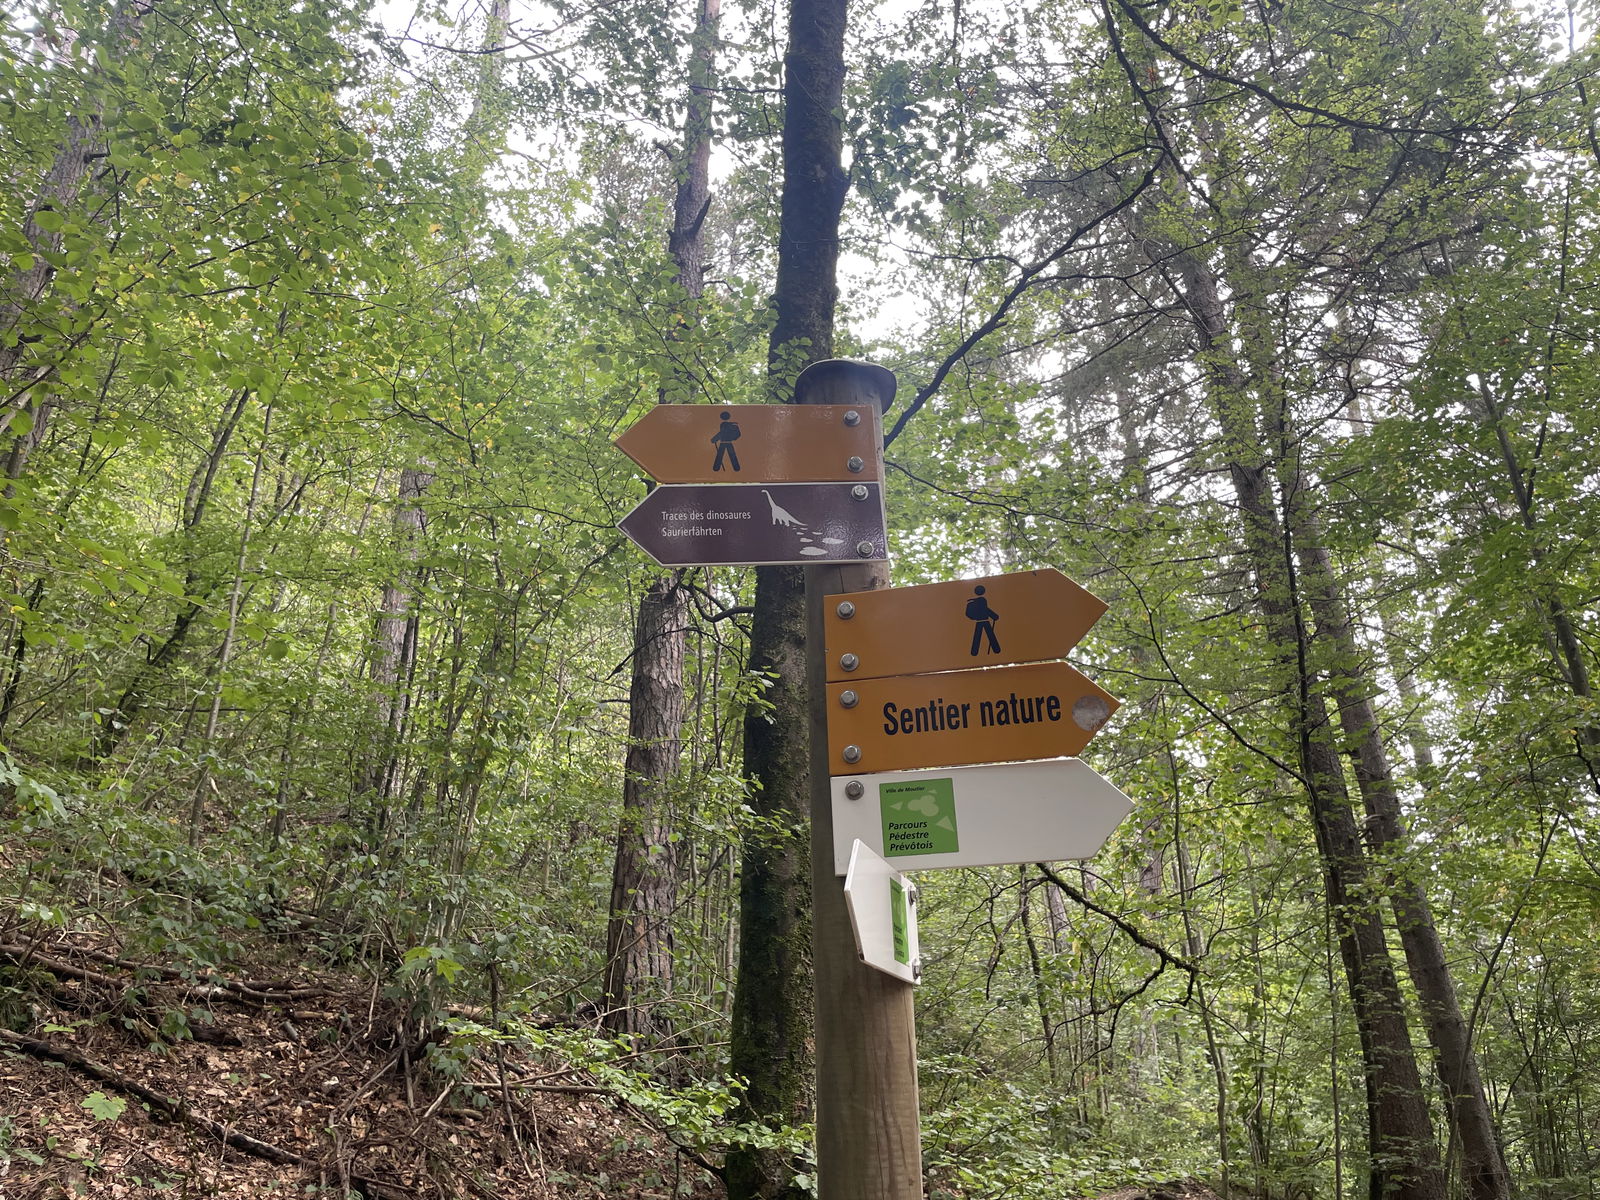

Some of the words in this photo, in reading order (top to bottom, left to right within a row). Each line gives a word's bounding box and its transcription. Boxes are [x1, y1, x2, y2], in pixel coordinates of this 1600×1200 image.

[661, 511, 688, 521] Traces
[689, 510, 704, 520] des
[706, 510, 752, 520] dinosaures
[662, 526, 722, 537] Saurierfährten
[883, 698, 970, 736] Sentier
[979, 693, 1061, 728] nature
[888, 821, 928, 831] Parcours
[889, 831, 929, 841] Pédestre
[890, 841, 934, 852] Prévôtois
